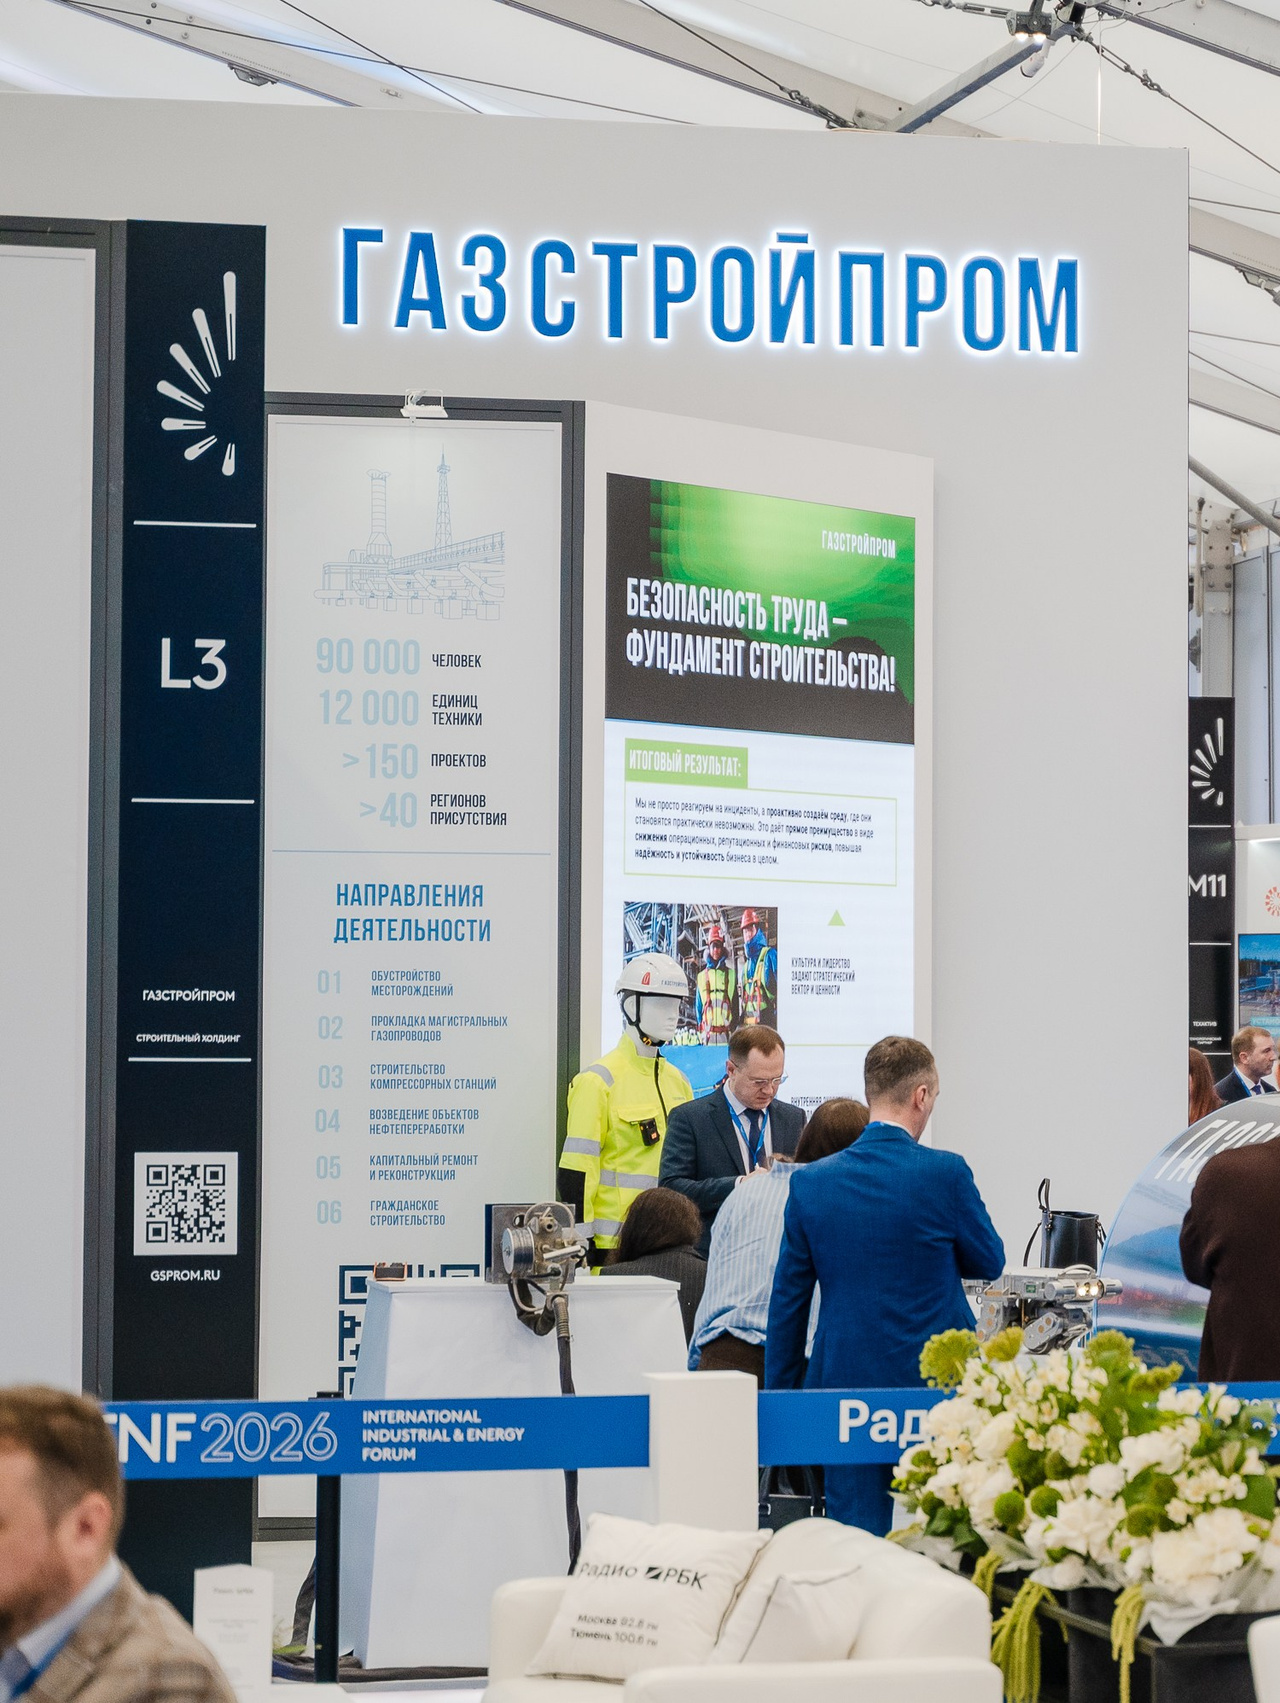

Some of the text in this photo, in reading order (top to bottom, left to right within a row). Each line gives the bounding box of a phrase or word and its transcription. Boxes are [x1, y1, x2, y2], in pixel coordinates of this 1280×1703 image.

[340, 227, 1082, 356] ГАЗСТРОЙПРОМ
[821, 529, 897, 558] ГАЗСТРОЙПРОМ
[626, 577, 767, 631] БЕЗОПАСНОСТЬ
[771, 595, 829, 641] ТРУДА
[161, 637, 228, 690] L3
[316, 637, 420, 675] 90 000
[432, 653, 482, 668] ЧЕЛОВЕК
[626, 628, 896, 692] ФУНДАМЕНТ СТРОИТЕЛЬСТВА!
[319, 689, 419, 726] 12 000
[432, 694, 478, 709] ЕДИНИЦ
[432, 712, 483, 726] ТЕХНИКИ
[431, 753, 487, 768] ПРОЕКТОВ
[629, 748, 742, 777] ИТОГОВЫЙ РЕЗУЛЬТАТ:
[430, 793, 487, 808] РЕГИОНОВ
[635, 798, 647, 809] Мы
[648, 800, 656, 809] не
[657, 801, 680, 812] просто
[681, 802, 714, 814] реагируем
[715, 804, 723, 813] на
[724, 805, 760, 816] инциденты,
[767, 807, 802, 818] проактивно
[803, 809, 829, 820] создаём
[850, 813, 860, 822] где
[861, 814, 872, 822] они
[430, 811, 507, 826] ПРИСУТСТВИЯ
[635, 816, 672, 826] становятся
[673, 817, 713, 829] практически
[715, 819, 756, 832] невозможны.
[758, 821, 769, 832] Это
[770, 821, 784, 833] даёт
[785, 824, 808, 835] прямое
[809, 826, 854, 838] преимущество
[860, 829, 874, 839] виде
[635, 832, 668, 843] снижения
[669, 834, 717, 847] операционных,
[718, 836, 765, 849] репутационных
[772, 837, 809, 851] финансовых
[835, 844, 862, 853] повышая
[635, 847, 674, 860] надёжность
[681, 850, 725, 863] устойчивость
[726, 851, 751, 863] бизнеса
[757, 855, 779, 865] целом.
[336, 883, 484, 907] НАПРАВЛЕНИЯ
[333, 918, 491, 943] ДЕЯТЕЛЬНОСТИ
[791, 957, 817, 968] КУЛЬТУРА
[822, 958, 850, 969] ЛИДЕРСТВО
[317, 969, 341, 994] 01
[371, 968, 441, 982] ОБУСТРОЙСТВО
[791, 970, 856, 982] ЗАДАЮТ СТРАТЕГИЧЕСКИЙ
[142, 988, 236, 1002] ГАЗСТРОЙПРОМ
[371, 983, 454, 997] МЕСТОРОЖДЕНИЙ
[791, 984, 810, 995] ВЕКТОР
[815, 984, 841, 996] ЦЕННОСТИ
[318, 1015, 343, 1040] 02
[371, 1015, 508, 1028] ПРОКЛАДКА МАГИСТРАЛЬНЫХ
[136, 1033, 241, 1044] СТРОИТЕЛЬНЫЙ ХОЛДИНГ
[371, 1030, 442, 1042] ГАЗОПРОВОДОВ
[318, 1064, 343, 1089] 03
[370, 1064, 446, 1075] СТРОИТЕЛЬСТВО
[370, 1076, 497, 1091] КОМПРЕССОРНЫХ СТАНЦИЙ
[315, 1108, 340, 1133] 04
[369, 1109, 480, 1121] ВОЗВЕДЕНИЕ ОБЪЕКТОВ
[369, 1123, 465, 1135] НЕФТЕПЕРЕРАБОТКИ
[369, 1153, 478, 1166] КАПИТАЛЬНЫЙ РЕМОНТ
[316, 1155, 341, 1180] 05
[369, 1169, 456, 1182] И РЕКОНСТРУКЦИЯ
[317, 1200, 342, 1225] 06
[370, 1200, 439, 1212] ГРАЖДАНСКОЕ
[370, 1214, 446, 1226] СТРОИТЕЛЬСТВО
[150, 1269, 220, 1282] GSPROM.RU
[362, 1409, 482, 1425] INTERNATIONAL
[839, 1398, 929, 1449] Рад
[200, 1411, 339, 1463] 2026
[362, 1426, 526, 1443] INDUSTRIAL & ENERGY
[362, 1447, 417, 1463] FORUM
[663, 1567, 708, 1590] РБК
[577, 1614, 618, 1625] Москва
[570, 1628, 612, 1641] Тюмень
